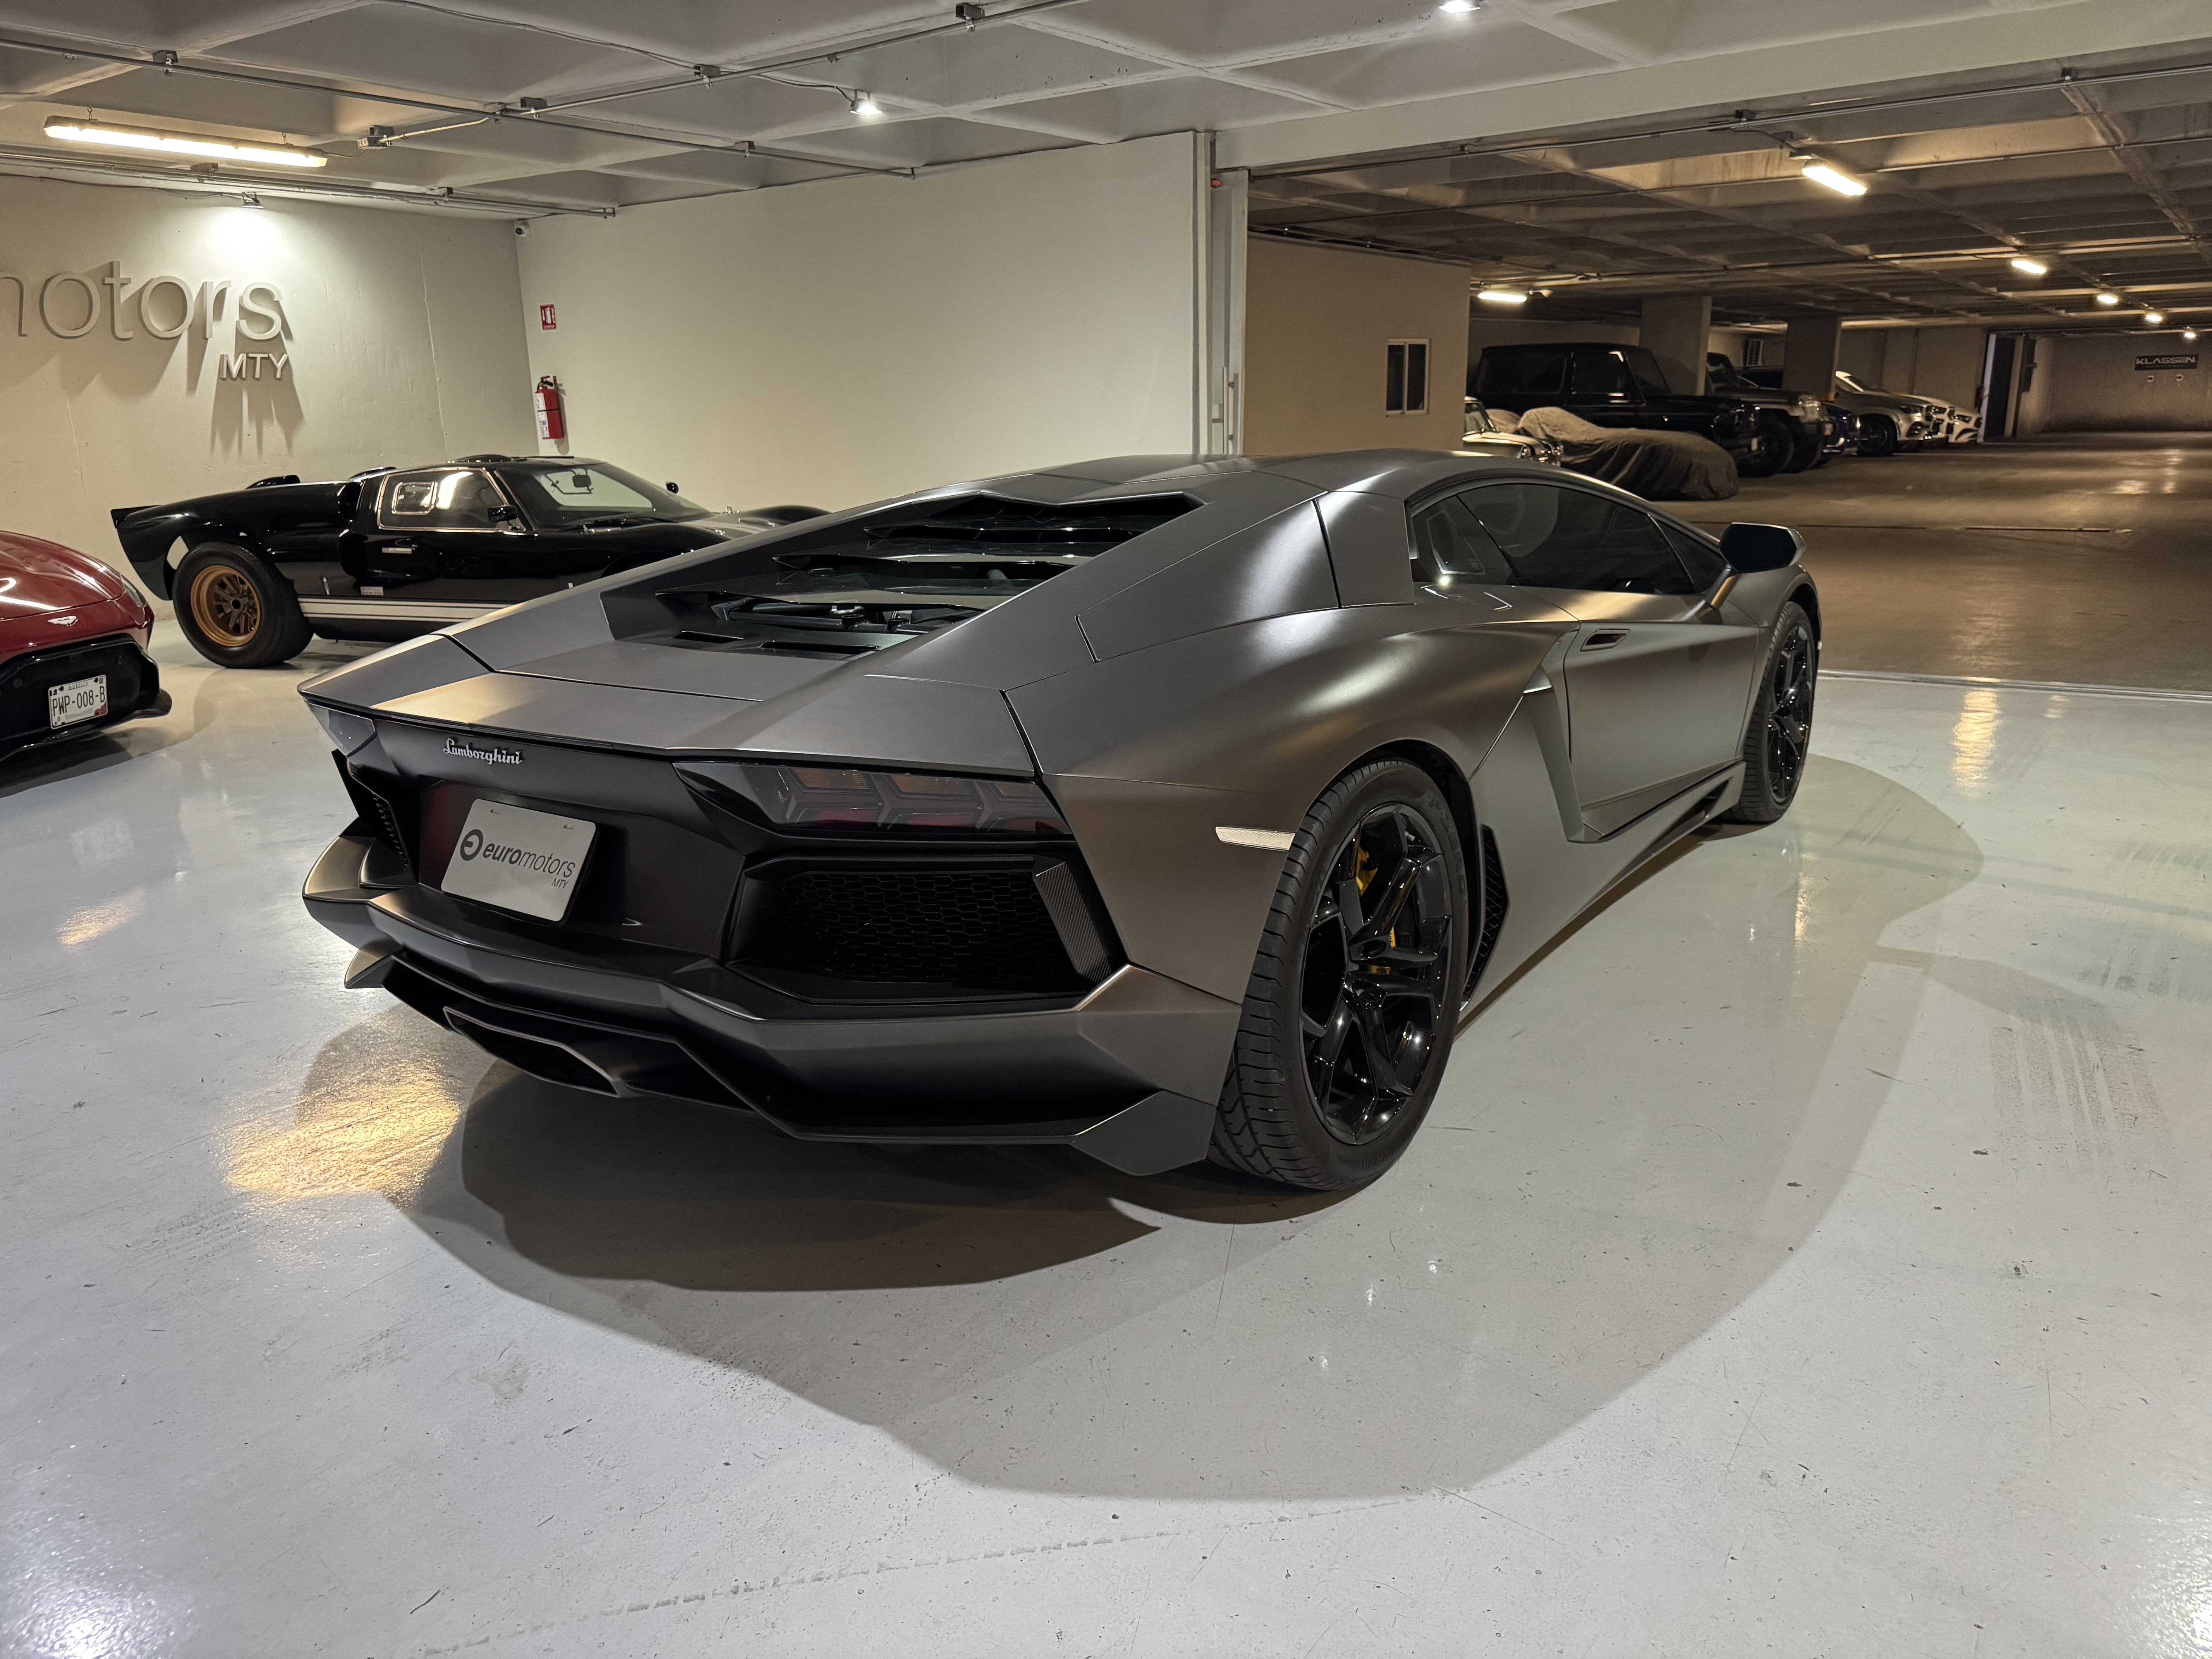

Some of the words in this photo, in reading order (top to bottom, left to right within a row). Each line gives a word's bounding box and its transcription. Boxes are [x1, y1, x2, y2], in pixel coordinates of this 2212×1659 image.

[220, 353, 289, 380] MTY
[2136, 356, 2196, 365] KLASSEN
[52, 685, 105, 717] PWP-008-B
[443, 738, 522, 765] Lamborghini
[483, 843, 575, 878] euromotors
[551, 878, 569, 889] MTY
